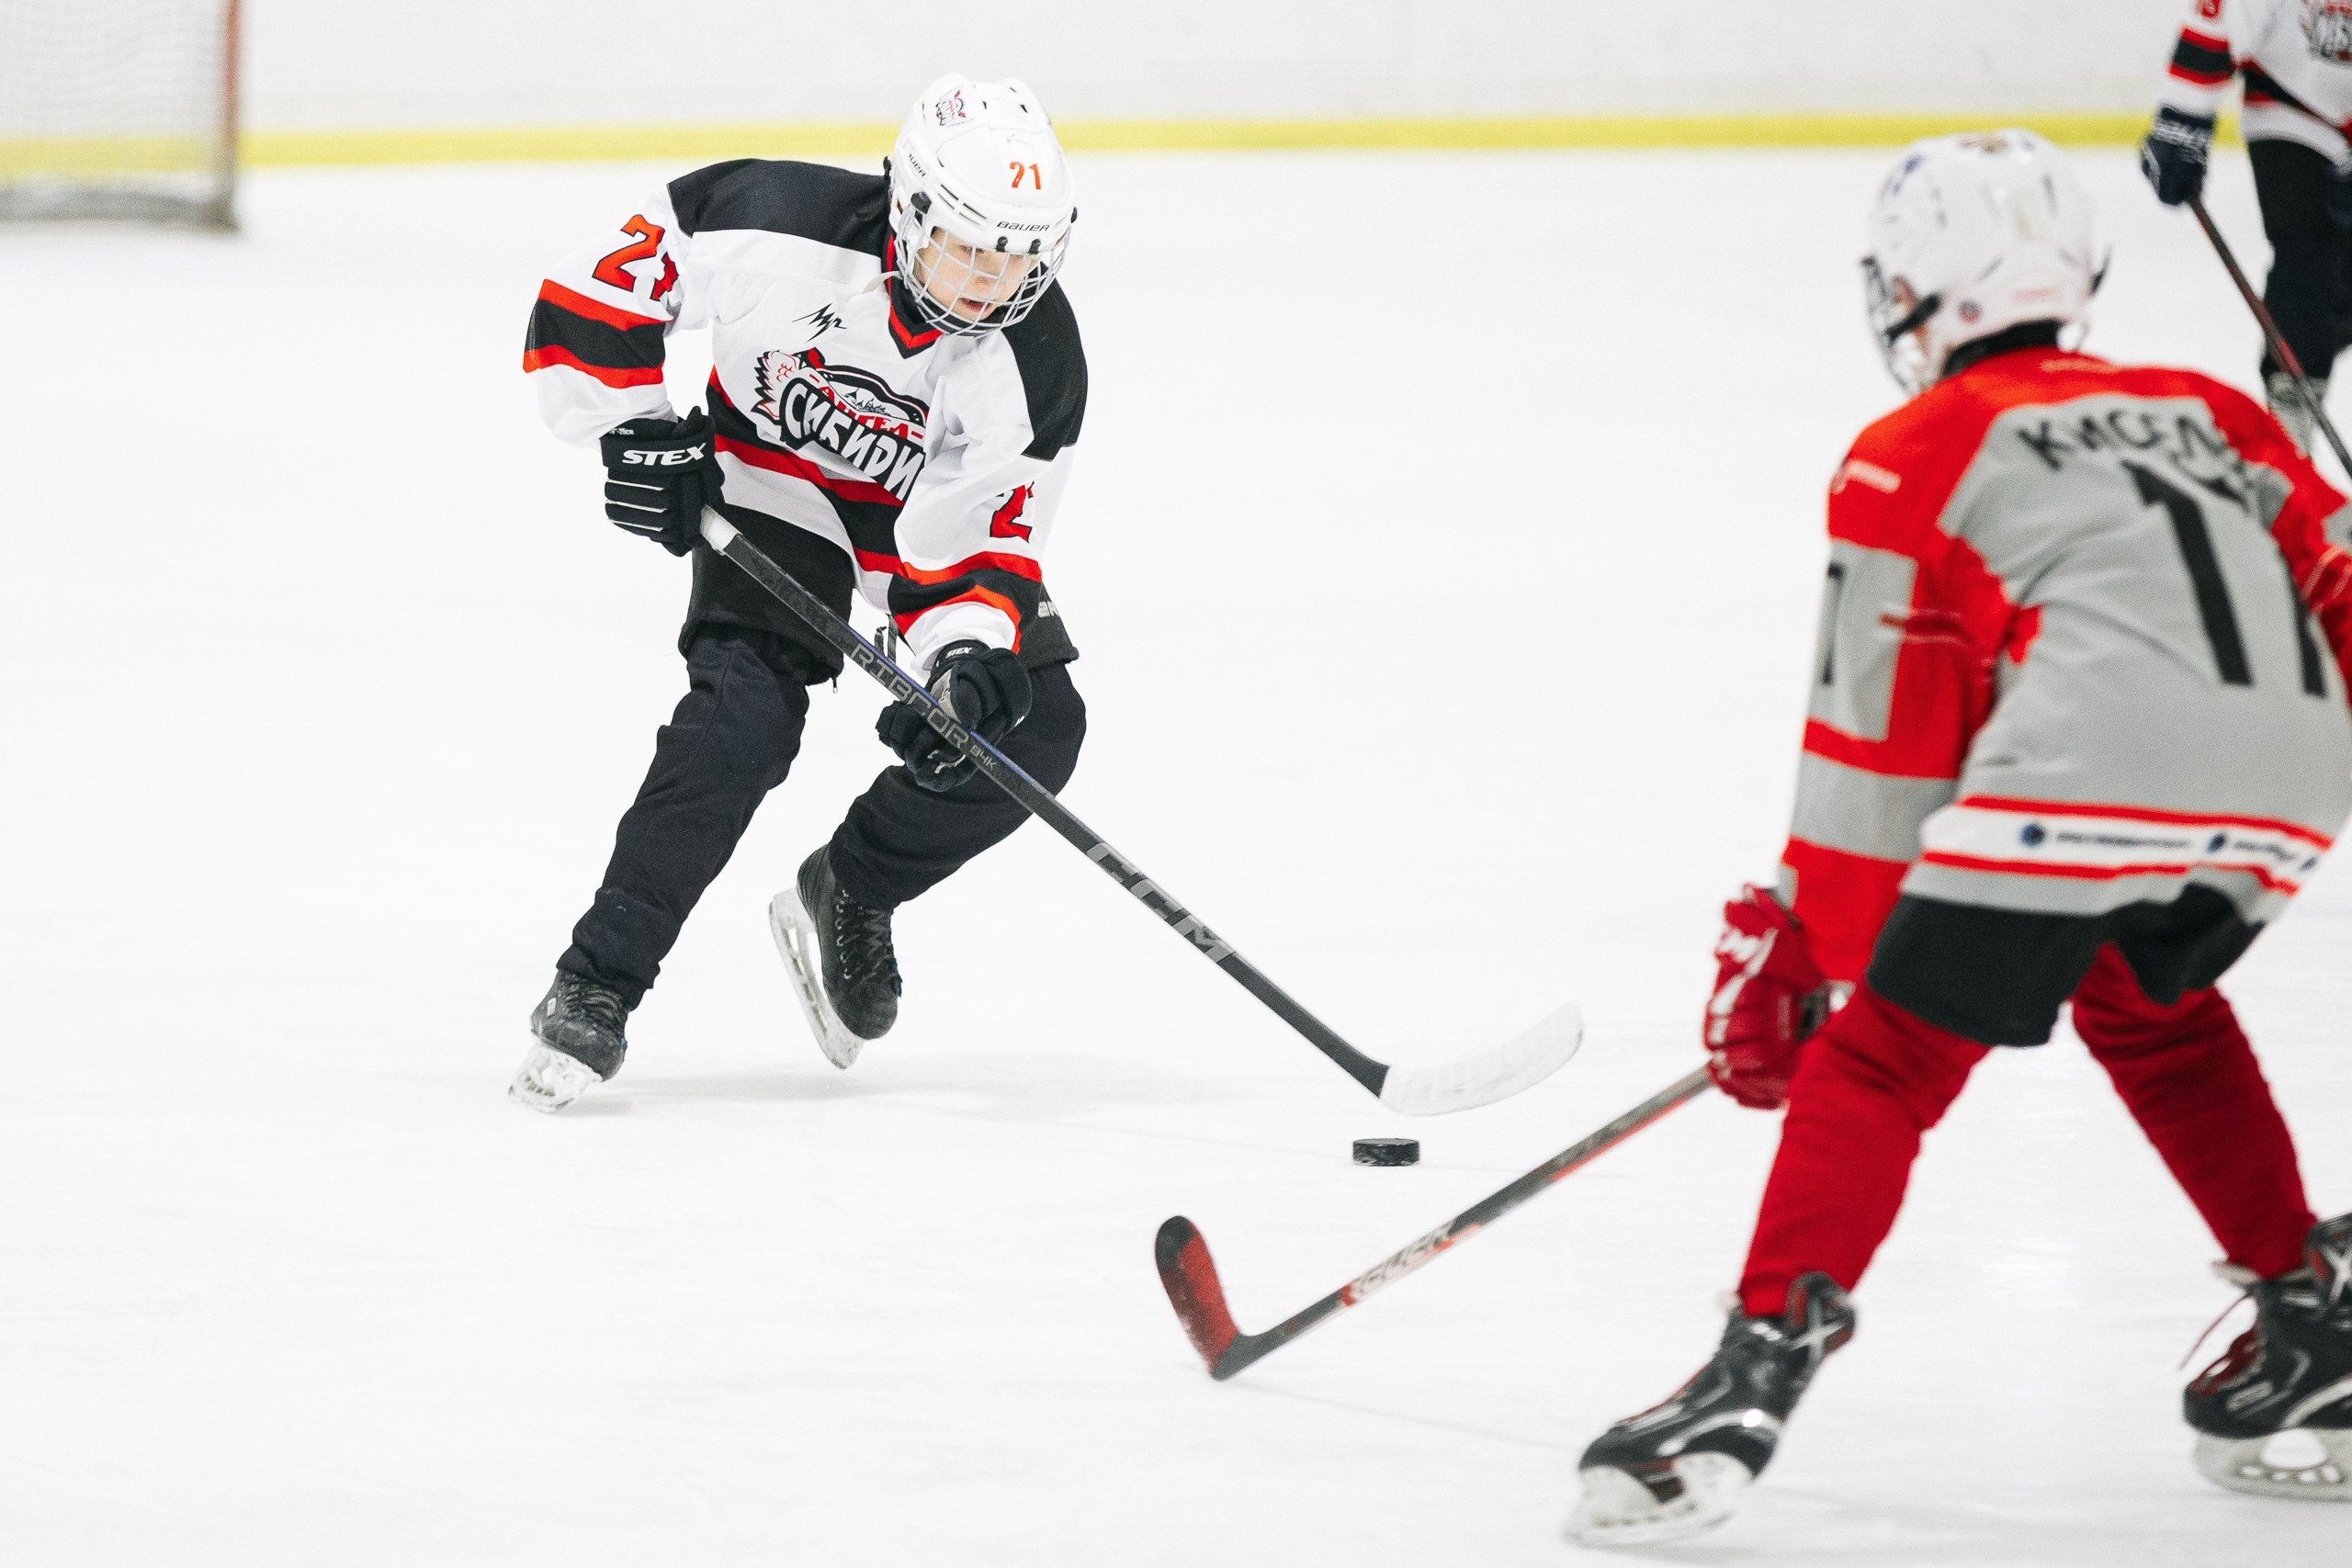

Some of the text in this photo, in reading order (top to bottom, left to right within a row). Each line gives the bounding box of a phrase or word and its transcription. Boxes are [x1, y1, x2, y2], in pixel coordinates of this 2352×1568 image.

[1009, 161, 1042, 190] 21
[996, 220, 1050, 232] BAUER
[622, 443, 707, 466] STEX
[989, 480, 1035, 545] 2
[850, 644, 969, 754] RIBCOR
[1085, 841, 1237, 964] CCM
